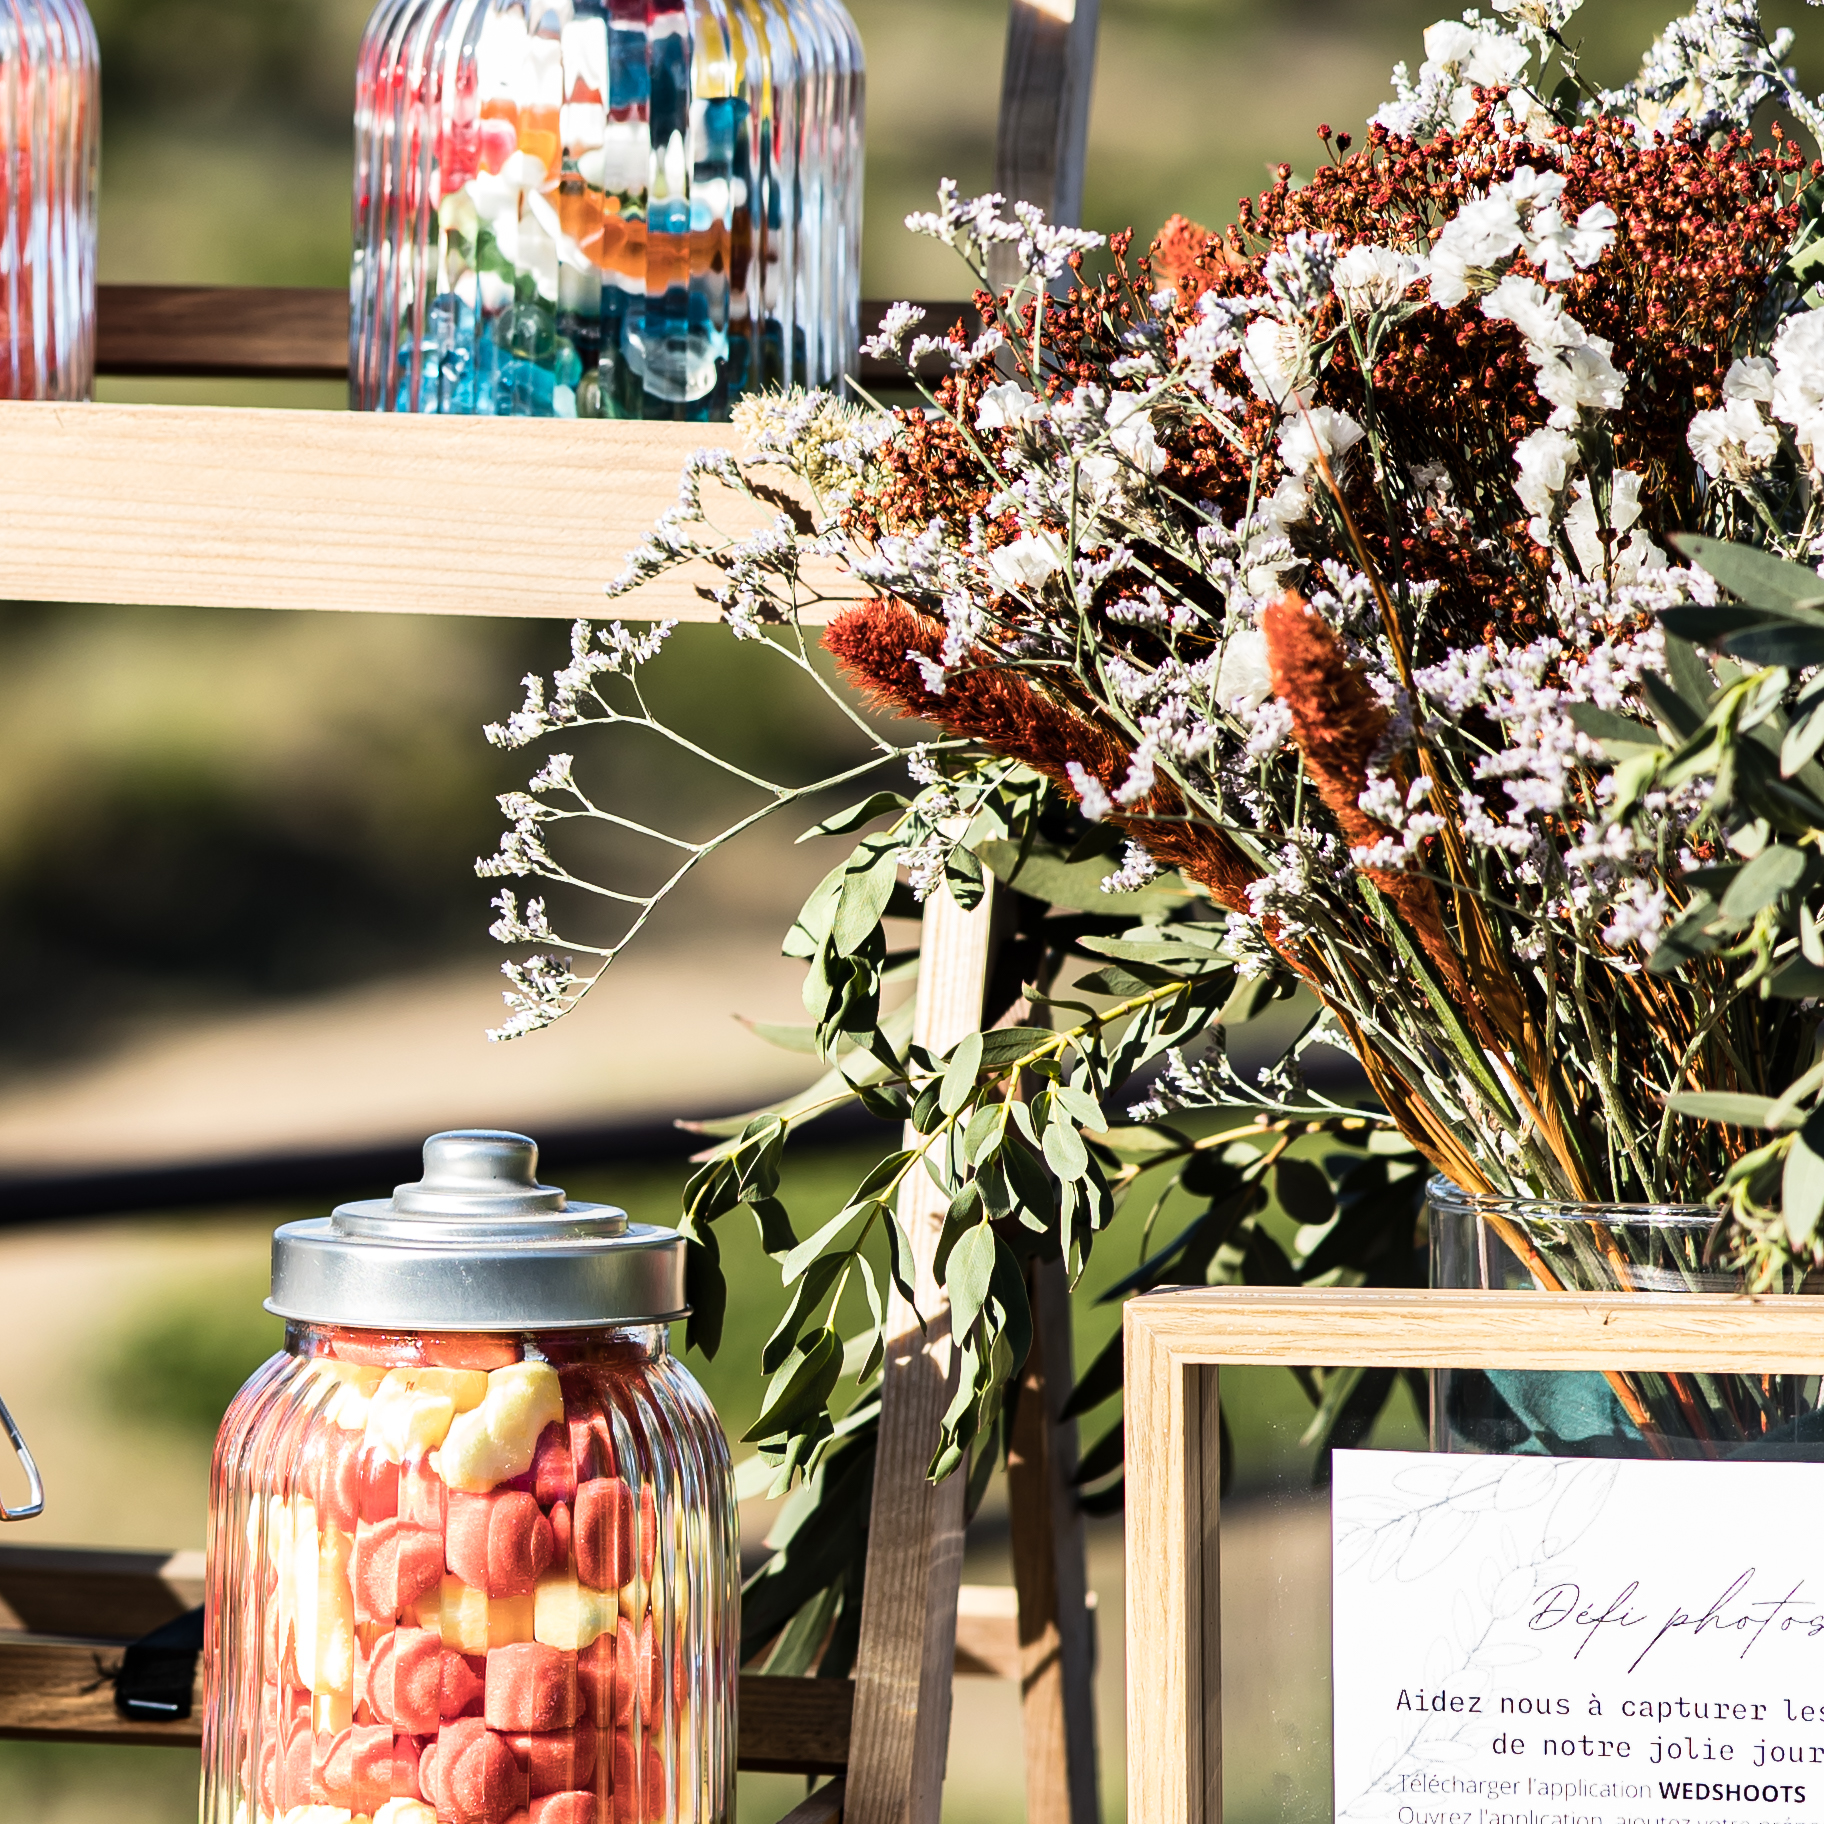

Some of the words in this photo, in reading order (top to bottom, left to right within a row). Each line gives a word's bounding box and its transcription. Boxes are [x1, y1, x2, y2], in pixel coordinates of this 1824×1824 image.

[1528, 1580, 1647, 1660] Défi
[1396, 1688, 1484, 1716] Aidez
[1500, 1696, 1570, 1715] nous
[1588, 1692, 1603, 1716] à
[1621, 1696, 1767, 1724] capturer
[1492, 1732, 1525, 1755] de
[1543, 1737, 1631, 1758] notre
[1649, 1737, 1734, 1764] jolie
[1398, 1772, 1521, 1800] Télécharger
[1528, 1777, 1652, 1802] l'application
[1658, 1781, 1806, 1804] WEDSHOOTS
